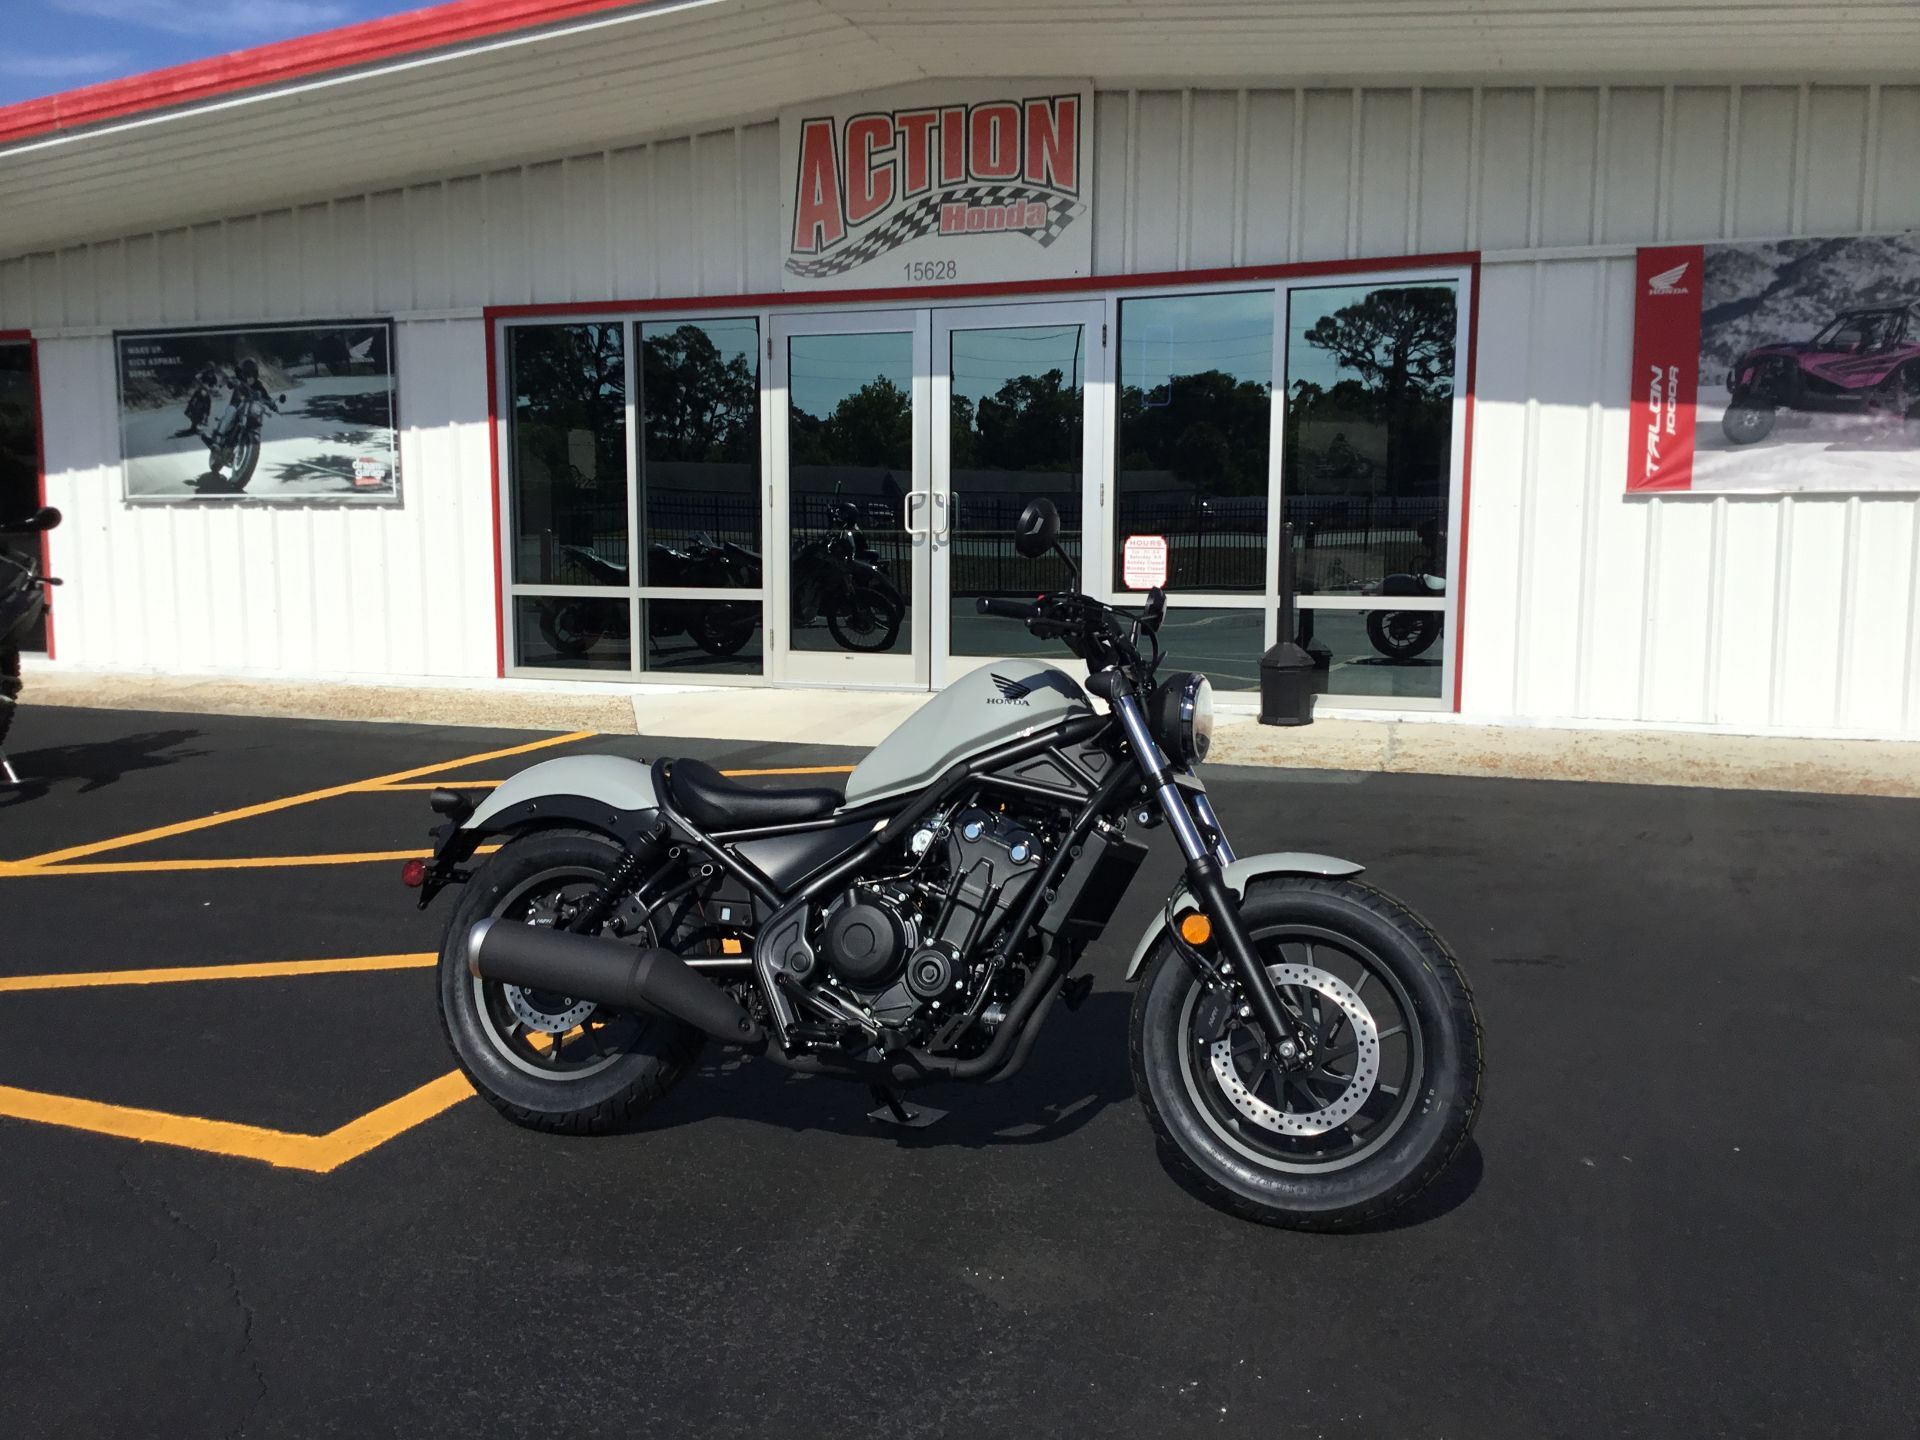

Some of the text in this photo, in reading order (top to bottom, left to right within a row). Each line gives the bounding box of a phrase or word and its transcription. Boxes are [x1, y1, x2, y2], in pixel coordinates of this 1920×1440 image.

[791, 94, 1081, 254] ACTION
[939, 198, 1048, 235] Honda
[903, 260, 957, 281] 15628
[1649, 288, 1689, 296] HONDA
[1645, 364, 1663, 478] TALON
[986, 698, 1030, 706] HONDA
